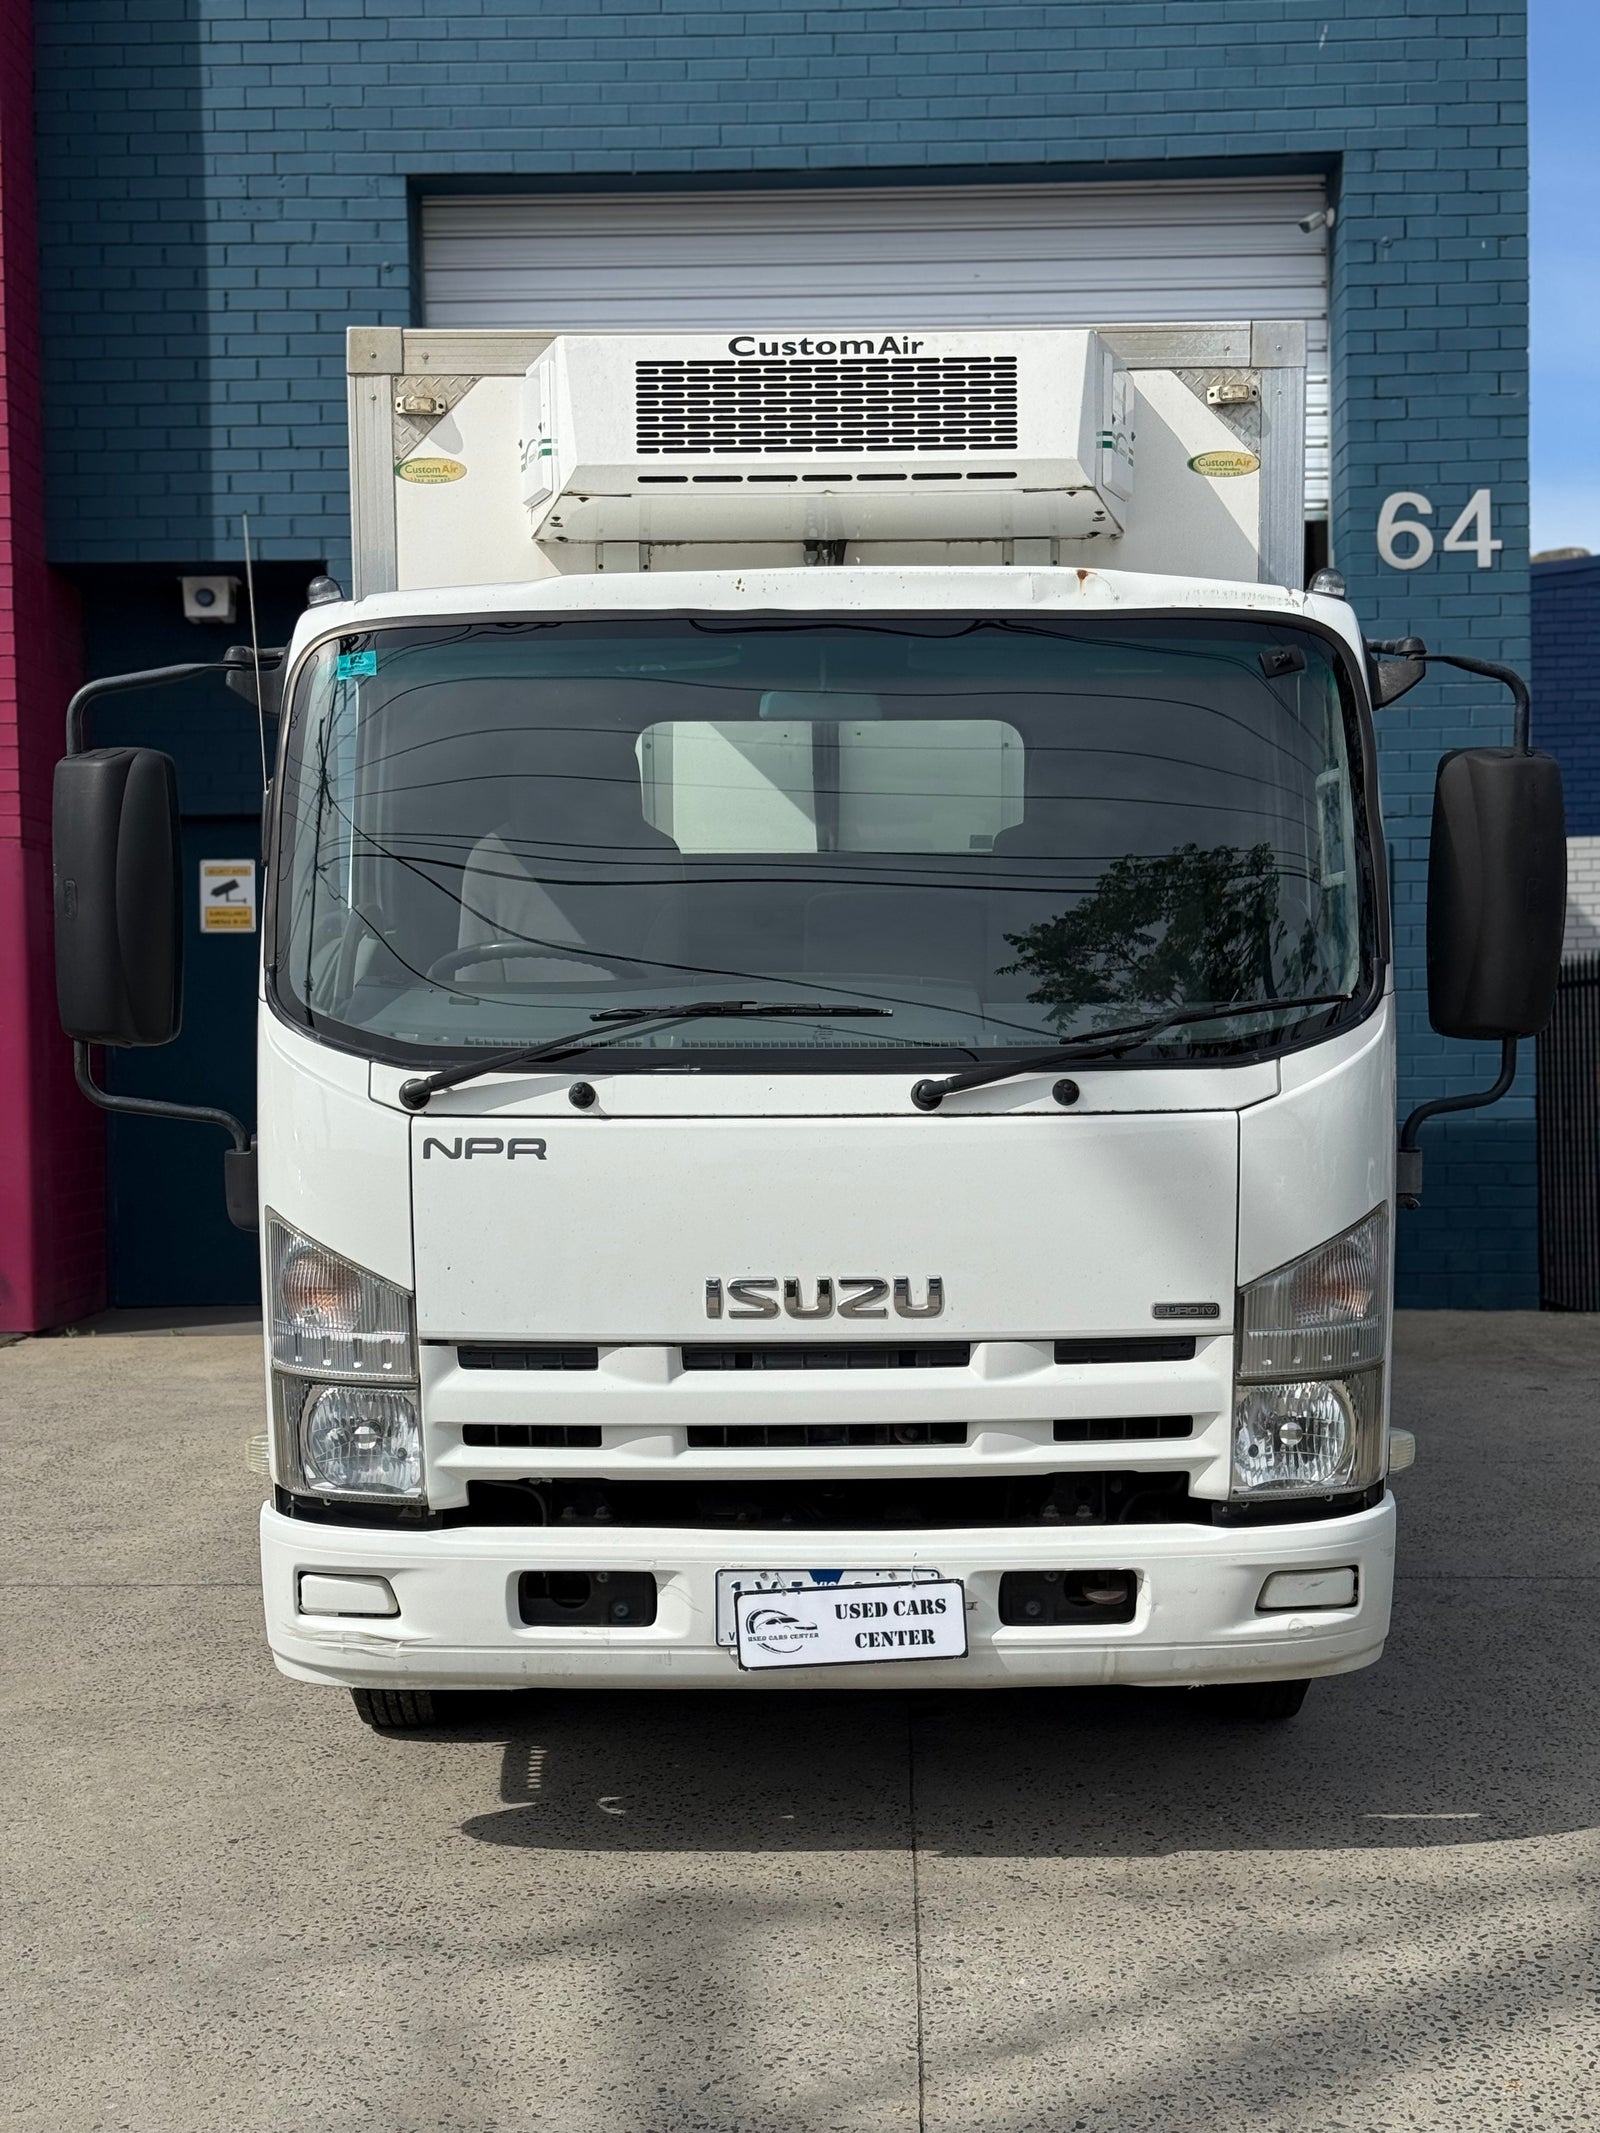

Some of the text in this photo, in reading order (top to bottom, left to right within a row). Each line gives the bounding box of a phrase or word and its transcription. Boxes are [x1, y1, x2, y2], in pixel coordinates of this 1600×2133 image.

[1377, 488, 1502, 570] 64
[423, 1137, 547, 1160] NPR
[706, 1275, 943, 1319] ISUZU
[834, 1598, 947, 1620] USED CARS
[854, 1629, 936, 1648] CENTER
